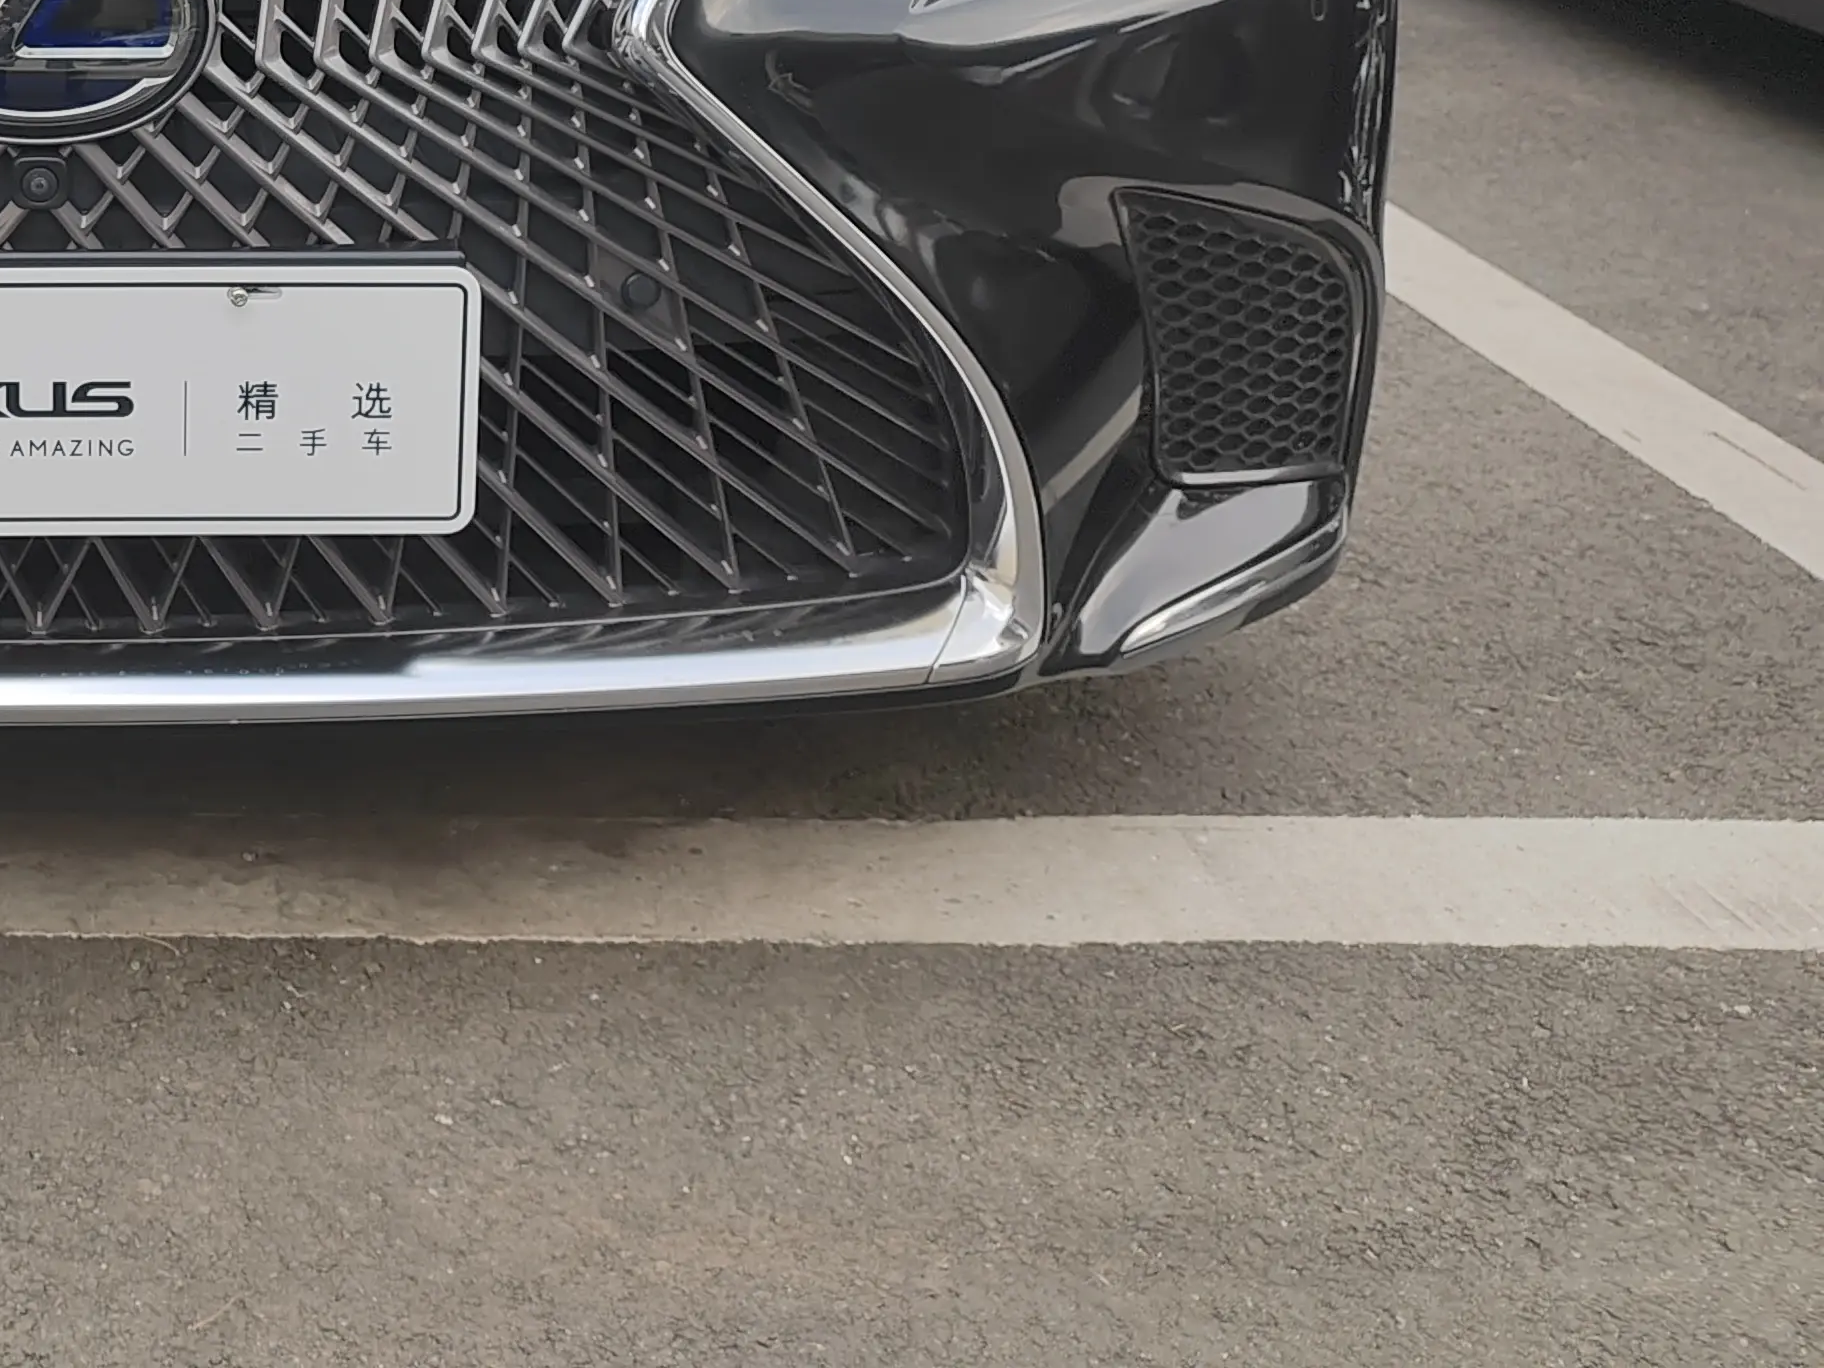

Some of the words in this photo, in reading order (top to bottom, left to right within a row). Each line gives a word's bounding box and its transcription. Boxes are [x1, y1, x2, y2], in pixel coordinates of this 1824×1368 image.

[10, 439, 134, 457] AMAZING
[236, 429, 392, 456] 二手车
